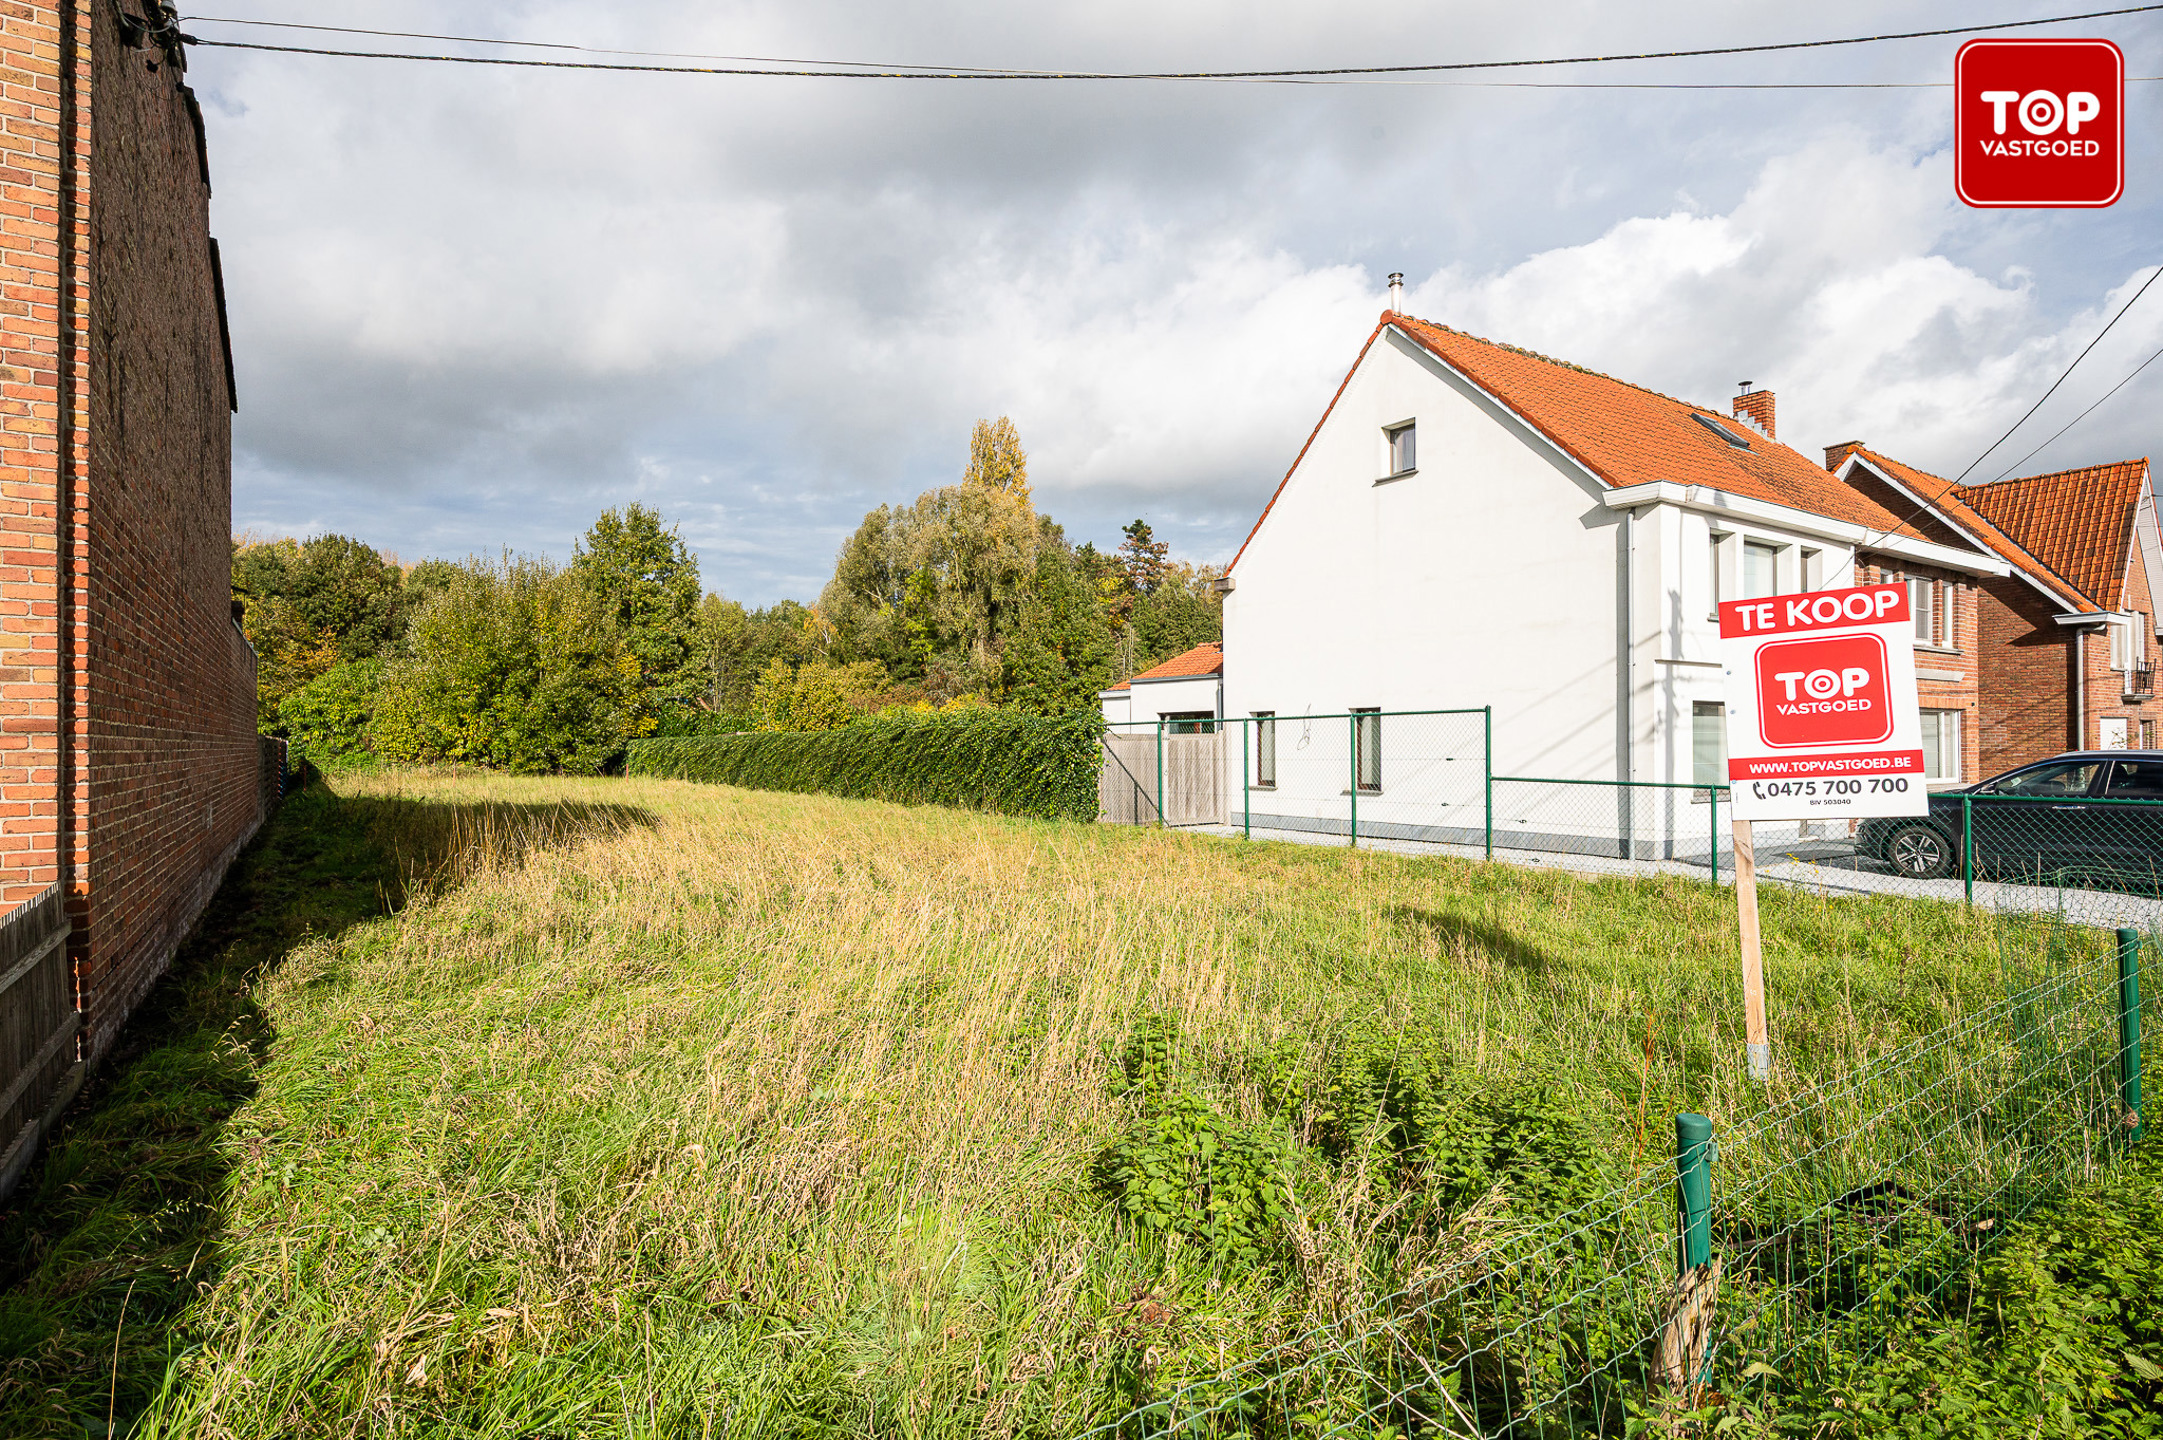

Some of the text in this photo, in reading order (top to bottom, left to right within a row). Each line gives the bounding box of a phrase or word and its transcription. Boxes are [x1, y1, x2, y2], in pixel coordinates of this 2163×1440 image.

[1735, 590, 1899, 631] TE KOOP
[1774, 667, 1870, 701] TOP
[1776, 698, 1872, 715] VASTGOED
[1749, 757, 1912, 774] WWW.TOPVASTGOED.BE
[1767, 778, 1909, 797] 0475 700 700
